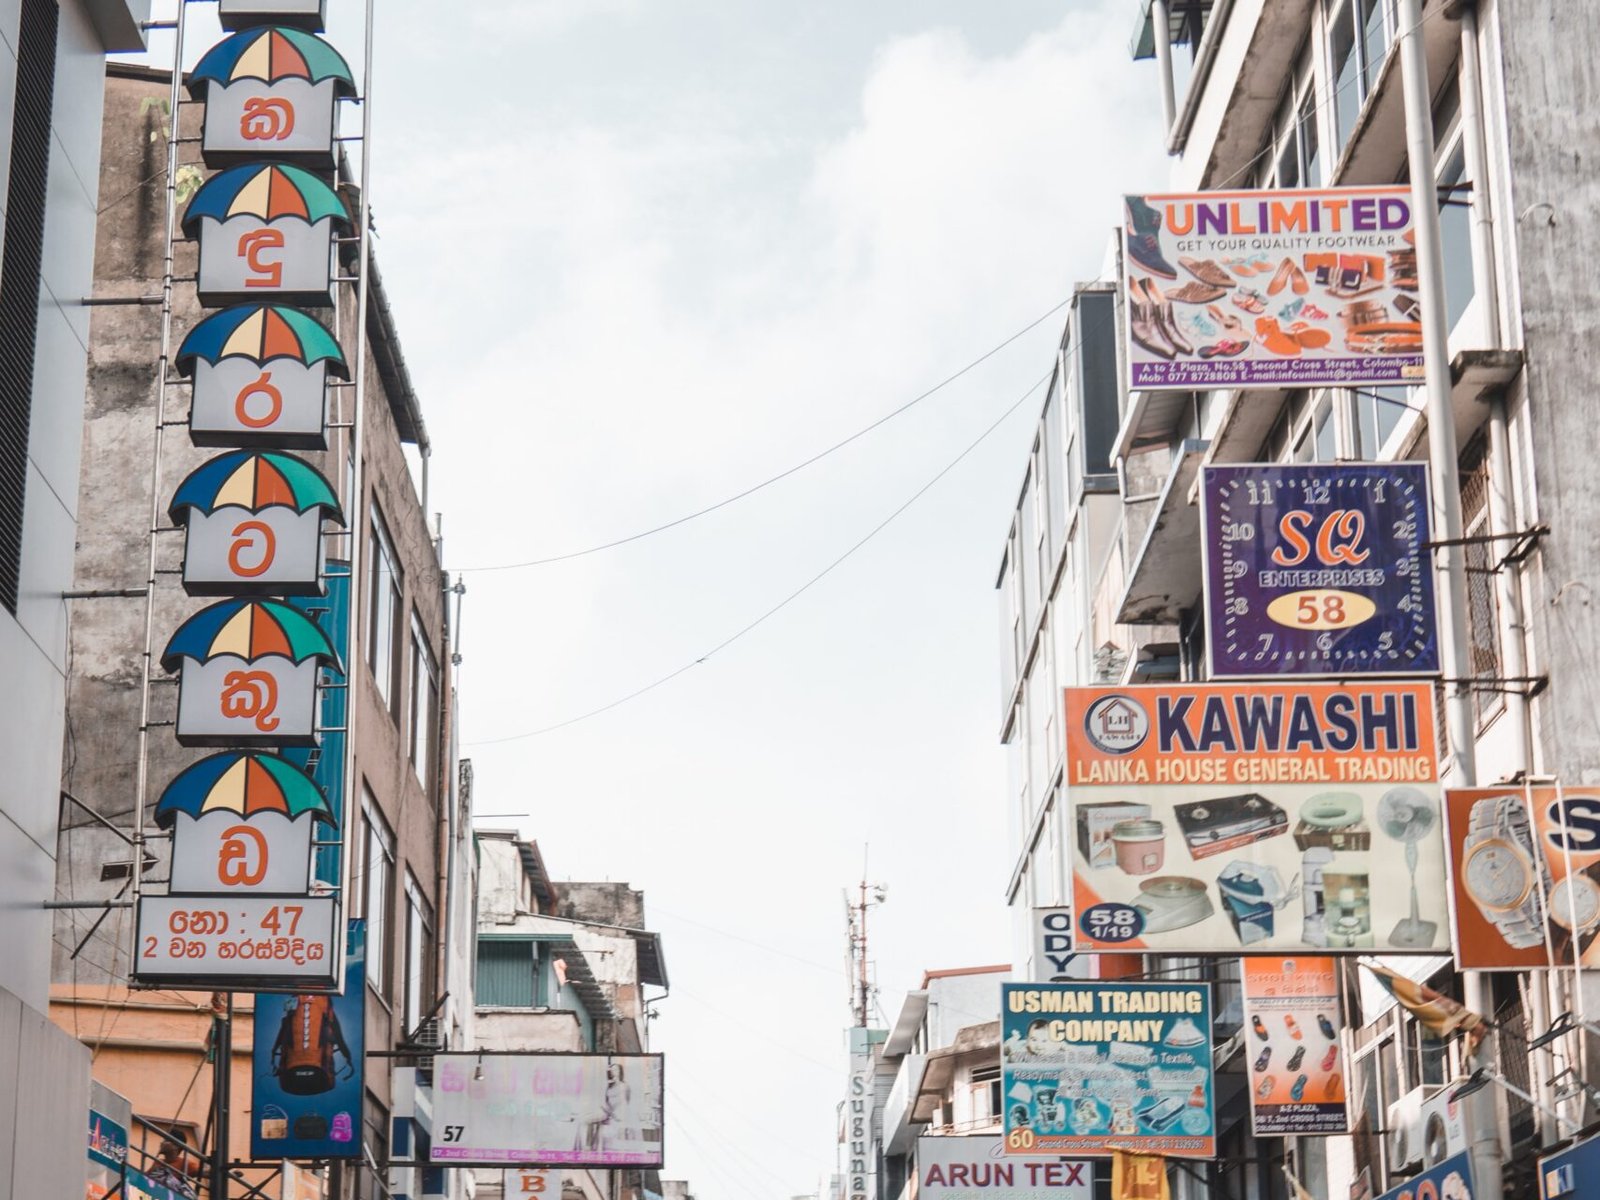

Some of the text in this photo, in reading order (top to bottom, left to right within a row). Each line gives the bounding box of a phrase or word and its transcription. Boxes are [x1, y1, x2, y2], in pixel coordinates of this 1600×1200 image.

[1165, 198, 1411, 236] UNLIMITED
[1176, 235, 1396, 252] GET YOUR QUALITY FOOTWEAR
[1142, 363, 1151, 373] A
[1154, 364, 1165, 373] to
[1180, 362, 1211, 373] Plaza,
[1251, 360, 1288, 371] Second
[1291, 359, 1321, 370] Cross
[1325, 358, 1360, 370] Street,
[1138, 373, 1164, 383] Mob:
[1168, 372, 1187, 382] 077
[1248, 485, 1385, 505] 11 12 1
[1230, 523, 1255, 541] 10
[1271, 508, 1371, 567] SQ
[1393, 520, 1409, 539] 2
[1233, 560, 1248, 578] 9
[1258, 568, 1386, 588] ENTERPRISES
[1395, 559, 1411, 577] 3
[1233, 597, 1249, 615] 8
[1297, 595, 1347, 625] 58
[1396, 595, 1412, 613] 4
[1258, 631, 1393, 652] 7 6 5
[1156, 693, 1420, 755] KAWASHI
[1076, 755, 1431, 784] LANKA HOUSE GENERAL TRADING
[168, 909, 229, 935] නො
[260, 906, 304, 936] 47
[1089, 908, 1137, 926] 58
[1091, 925, 1133, 938] 1/19
[143, 936, 159, 959] 2
[168, 936, 207, 959] වන
[1008, 990, 1203, 1014] USMAN TRADING
[1048, 1019, 1165, 1044] COMPANY
[443, 1125, 465, 1143] 57
[851, 1076, 866, 1191] Suguna
[1008, 1129, 1034, 1149] 60
[924, 1162, 1086, 1188] ARUN TEX
